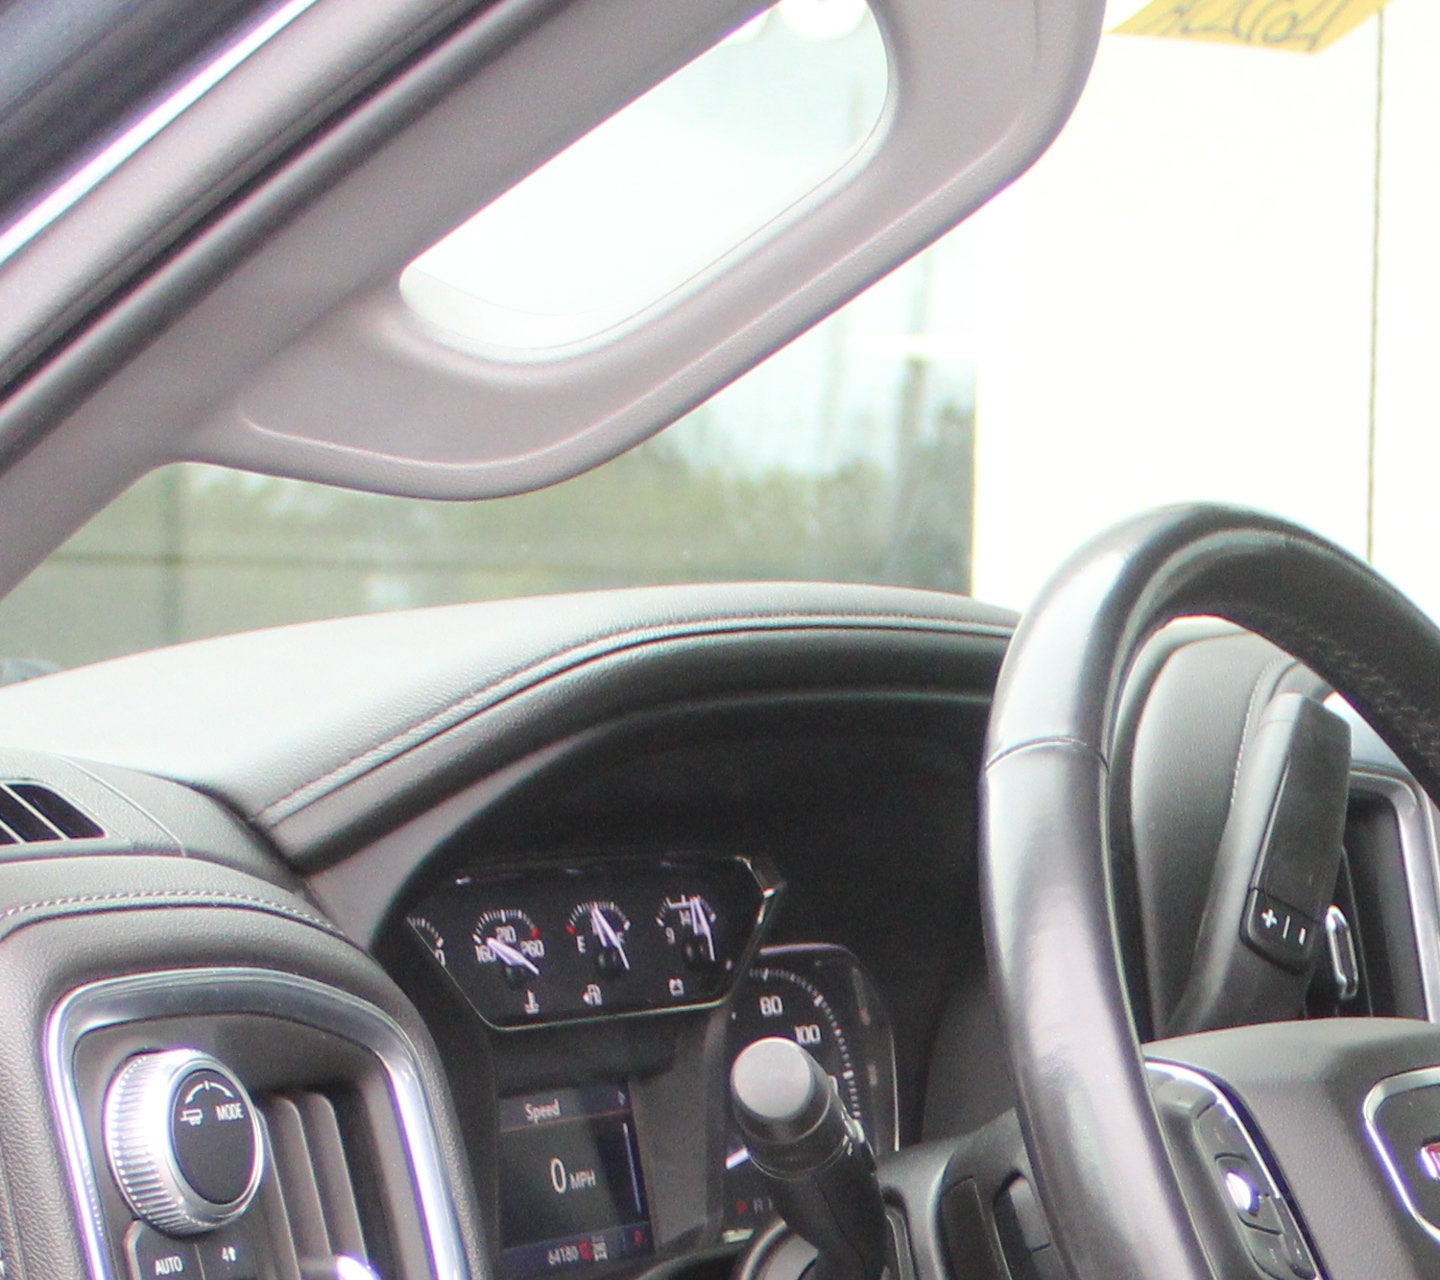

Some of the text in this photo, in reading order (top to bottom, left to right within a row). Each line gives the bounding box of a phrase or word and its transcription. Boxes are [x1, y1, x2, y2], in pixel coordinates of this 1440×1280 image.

[576, 935, 587, 954] E
[759, 995, 783, 1017] 80
[793, 1024, 821, 1045] 100
[215, 1102, 244, 1121] MODE
[524, 1099, 561, 1124] Speed
[549, 1156, 597, 1194] 0 MPH
[154, 1255, 184, 1276] AUTO
